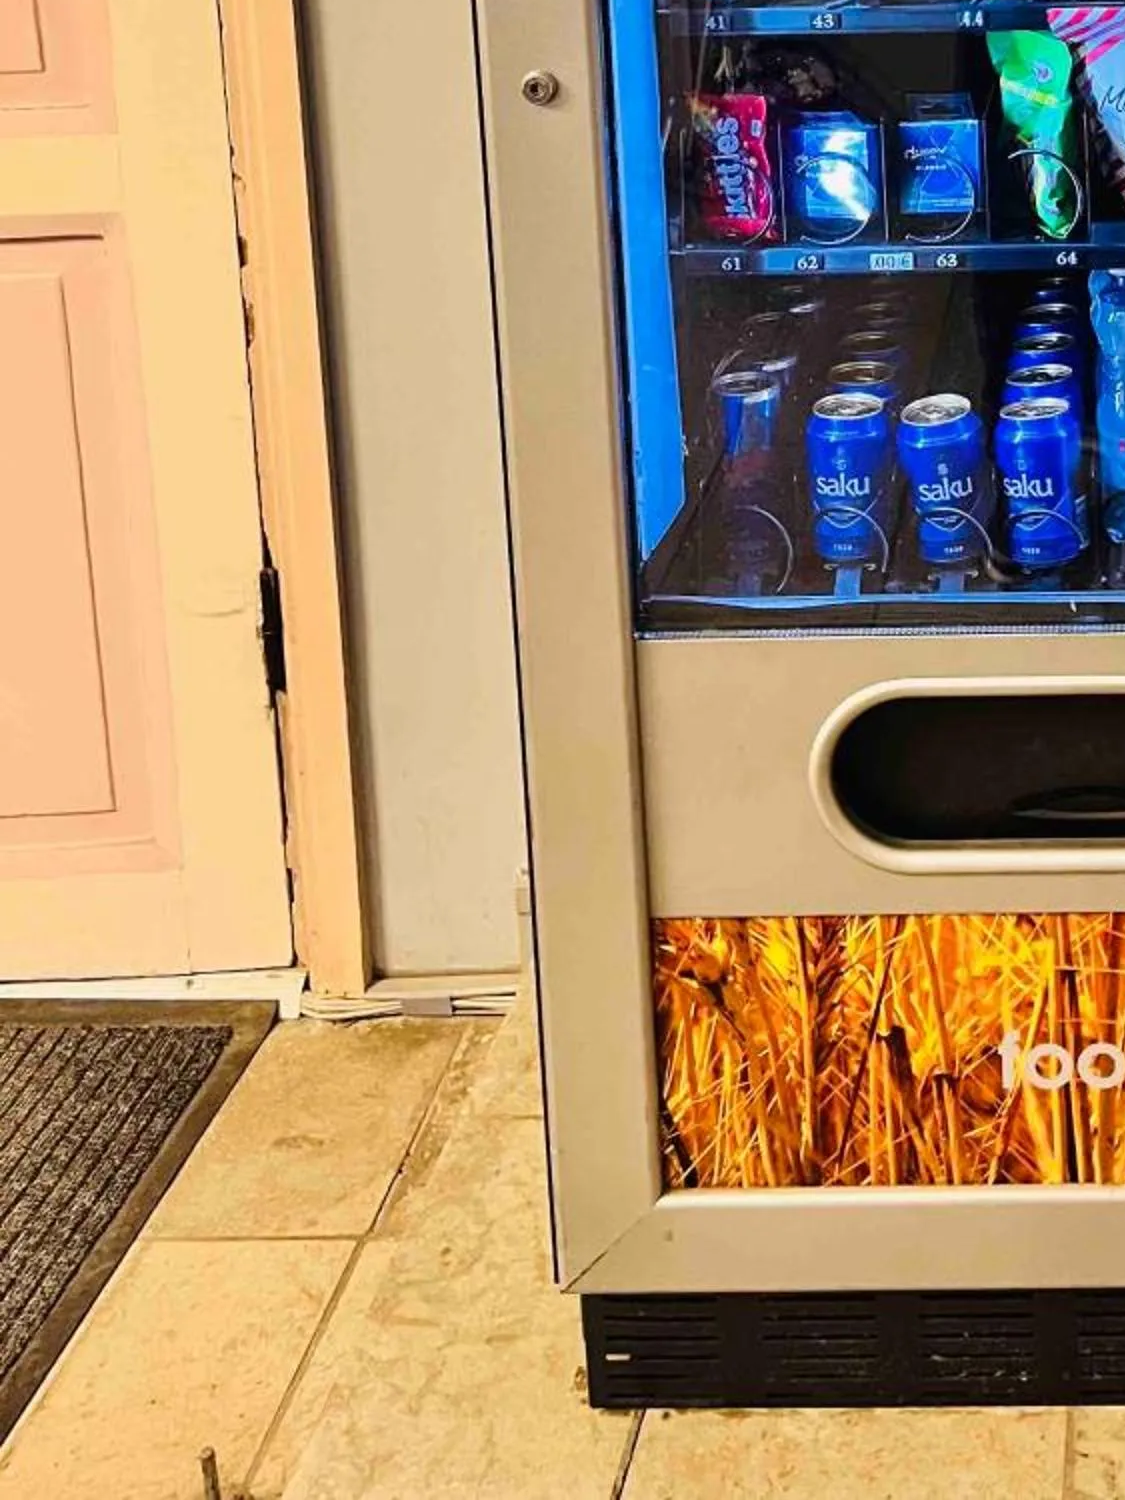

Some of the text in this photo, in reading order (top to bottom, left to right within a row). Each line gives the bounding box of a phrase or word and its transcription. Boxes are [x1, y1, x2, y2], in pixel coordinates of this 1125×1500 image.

[811, 13, 836, 29] 43
[721, 256, 743, 272] 61
[797, 254, 819, 270] 62
[936, 253, 958, 268] 63
[1056, 251, 1078, 266] 64
[816, 472, 871, 497] saku
[917, 476, 974, 502] saku
[1003, 473, 1054, 498] saku
